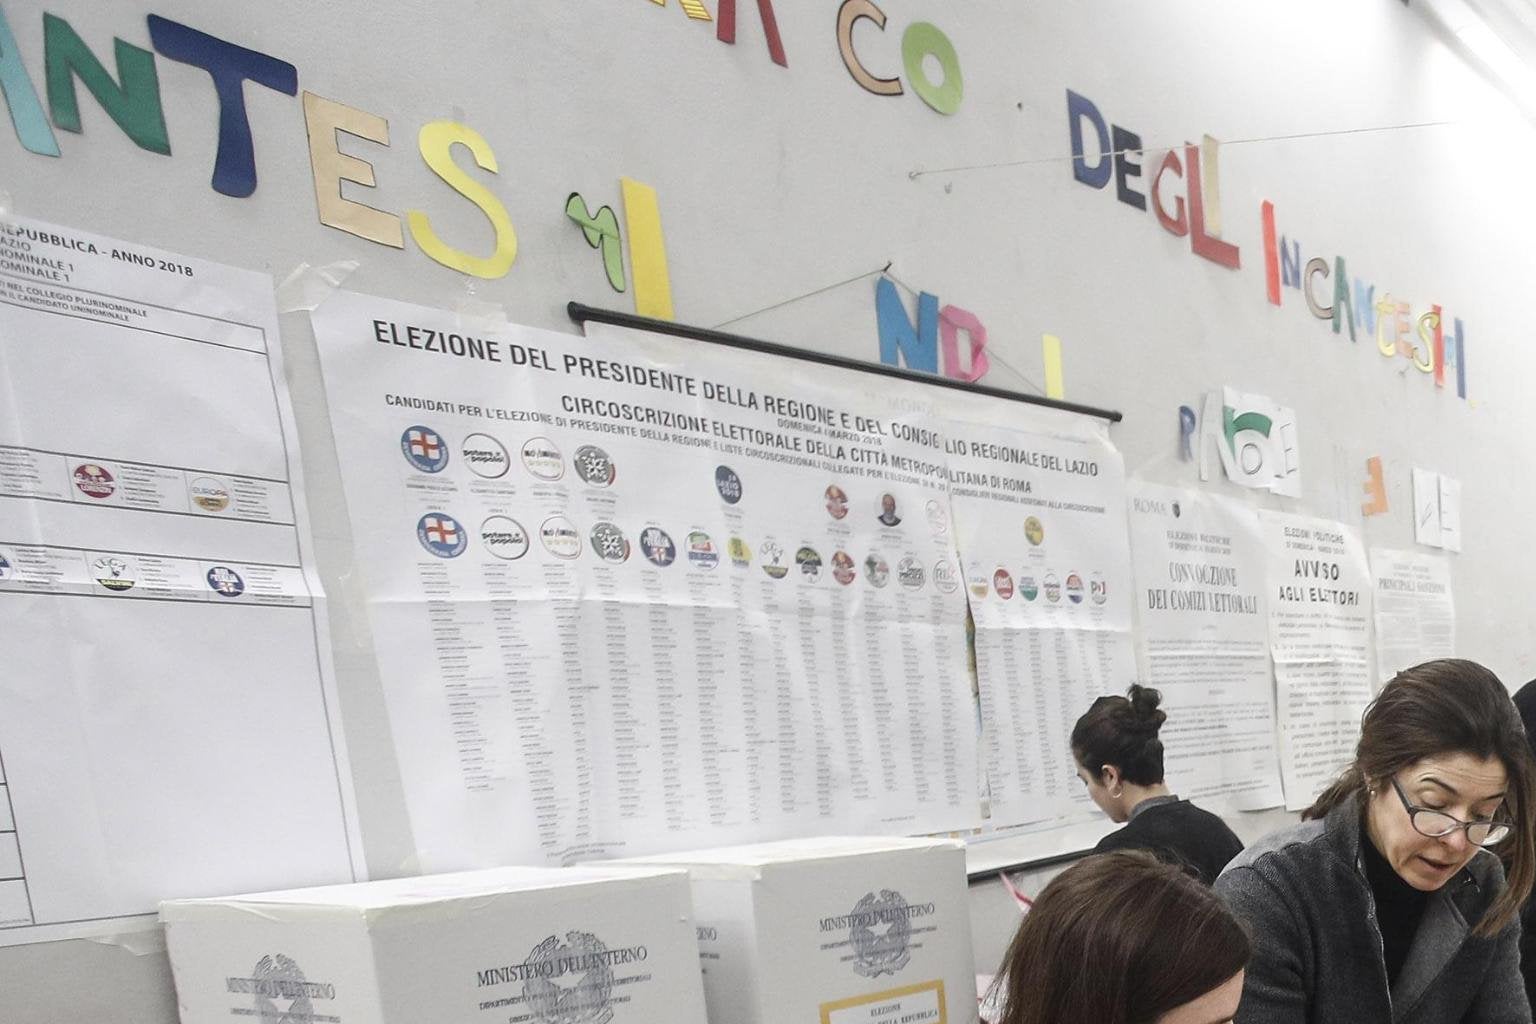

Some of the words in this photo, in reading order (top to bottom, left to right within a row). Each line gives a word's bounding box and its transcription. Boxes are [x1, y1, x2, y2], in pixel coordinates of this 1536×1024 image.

[1066, 88, 1240, 270] DEGLI
[111, 248, 155, 268] ANNO
[159, 260, 194, 277] 2018
[373, 320, 502, 362] ELEZIONE
[510, 344, 557, 372] DEL
[563, 354, 697, 397] PRESIDENTE
[703, 380, 759, 411] DELLA
[764, 395, 836, 427] REGIONE
[840, 413, 850, 429] E
[856, 416, 888, 436] DEL
[971, 441, 1040, 468] REGIONALE
[1041, 455, 1063, 472] DEL
[1065, 459, 1099, 477] LAZIO
[385, 394, 455, 414] CANDIDATI
[459, 404, 483, 417] PER
[570, 418, 637, 438] PRESIDENTE
[562, 394, 709, 434] CIRCOSCRIZIONE
[712, 421, 801, 451] ELETTORALE
[805, 439, 846, 460] DELLA
[990, 475, 1001, 487] DI
[1003, 478, 1032, 493] ROMA
[1279, 586, 1304, 602] AGLI
[476, 959, 553, 988] MINISTERO
[556, 945, 648, 975] DELL'INTERNO
